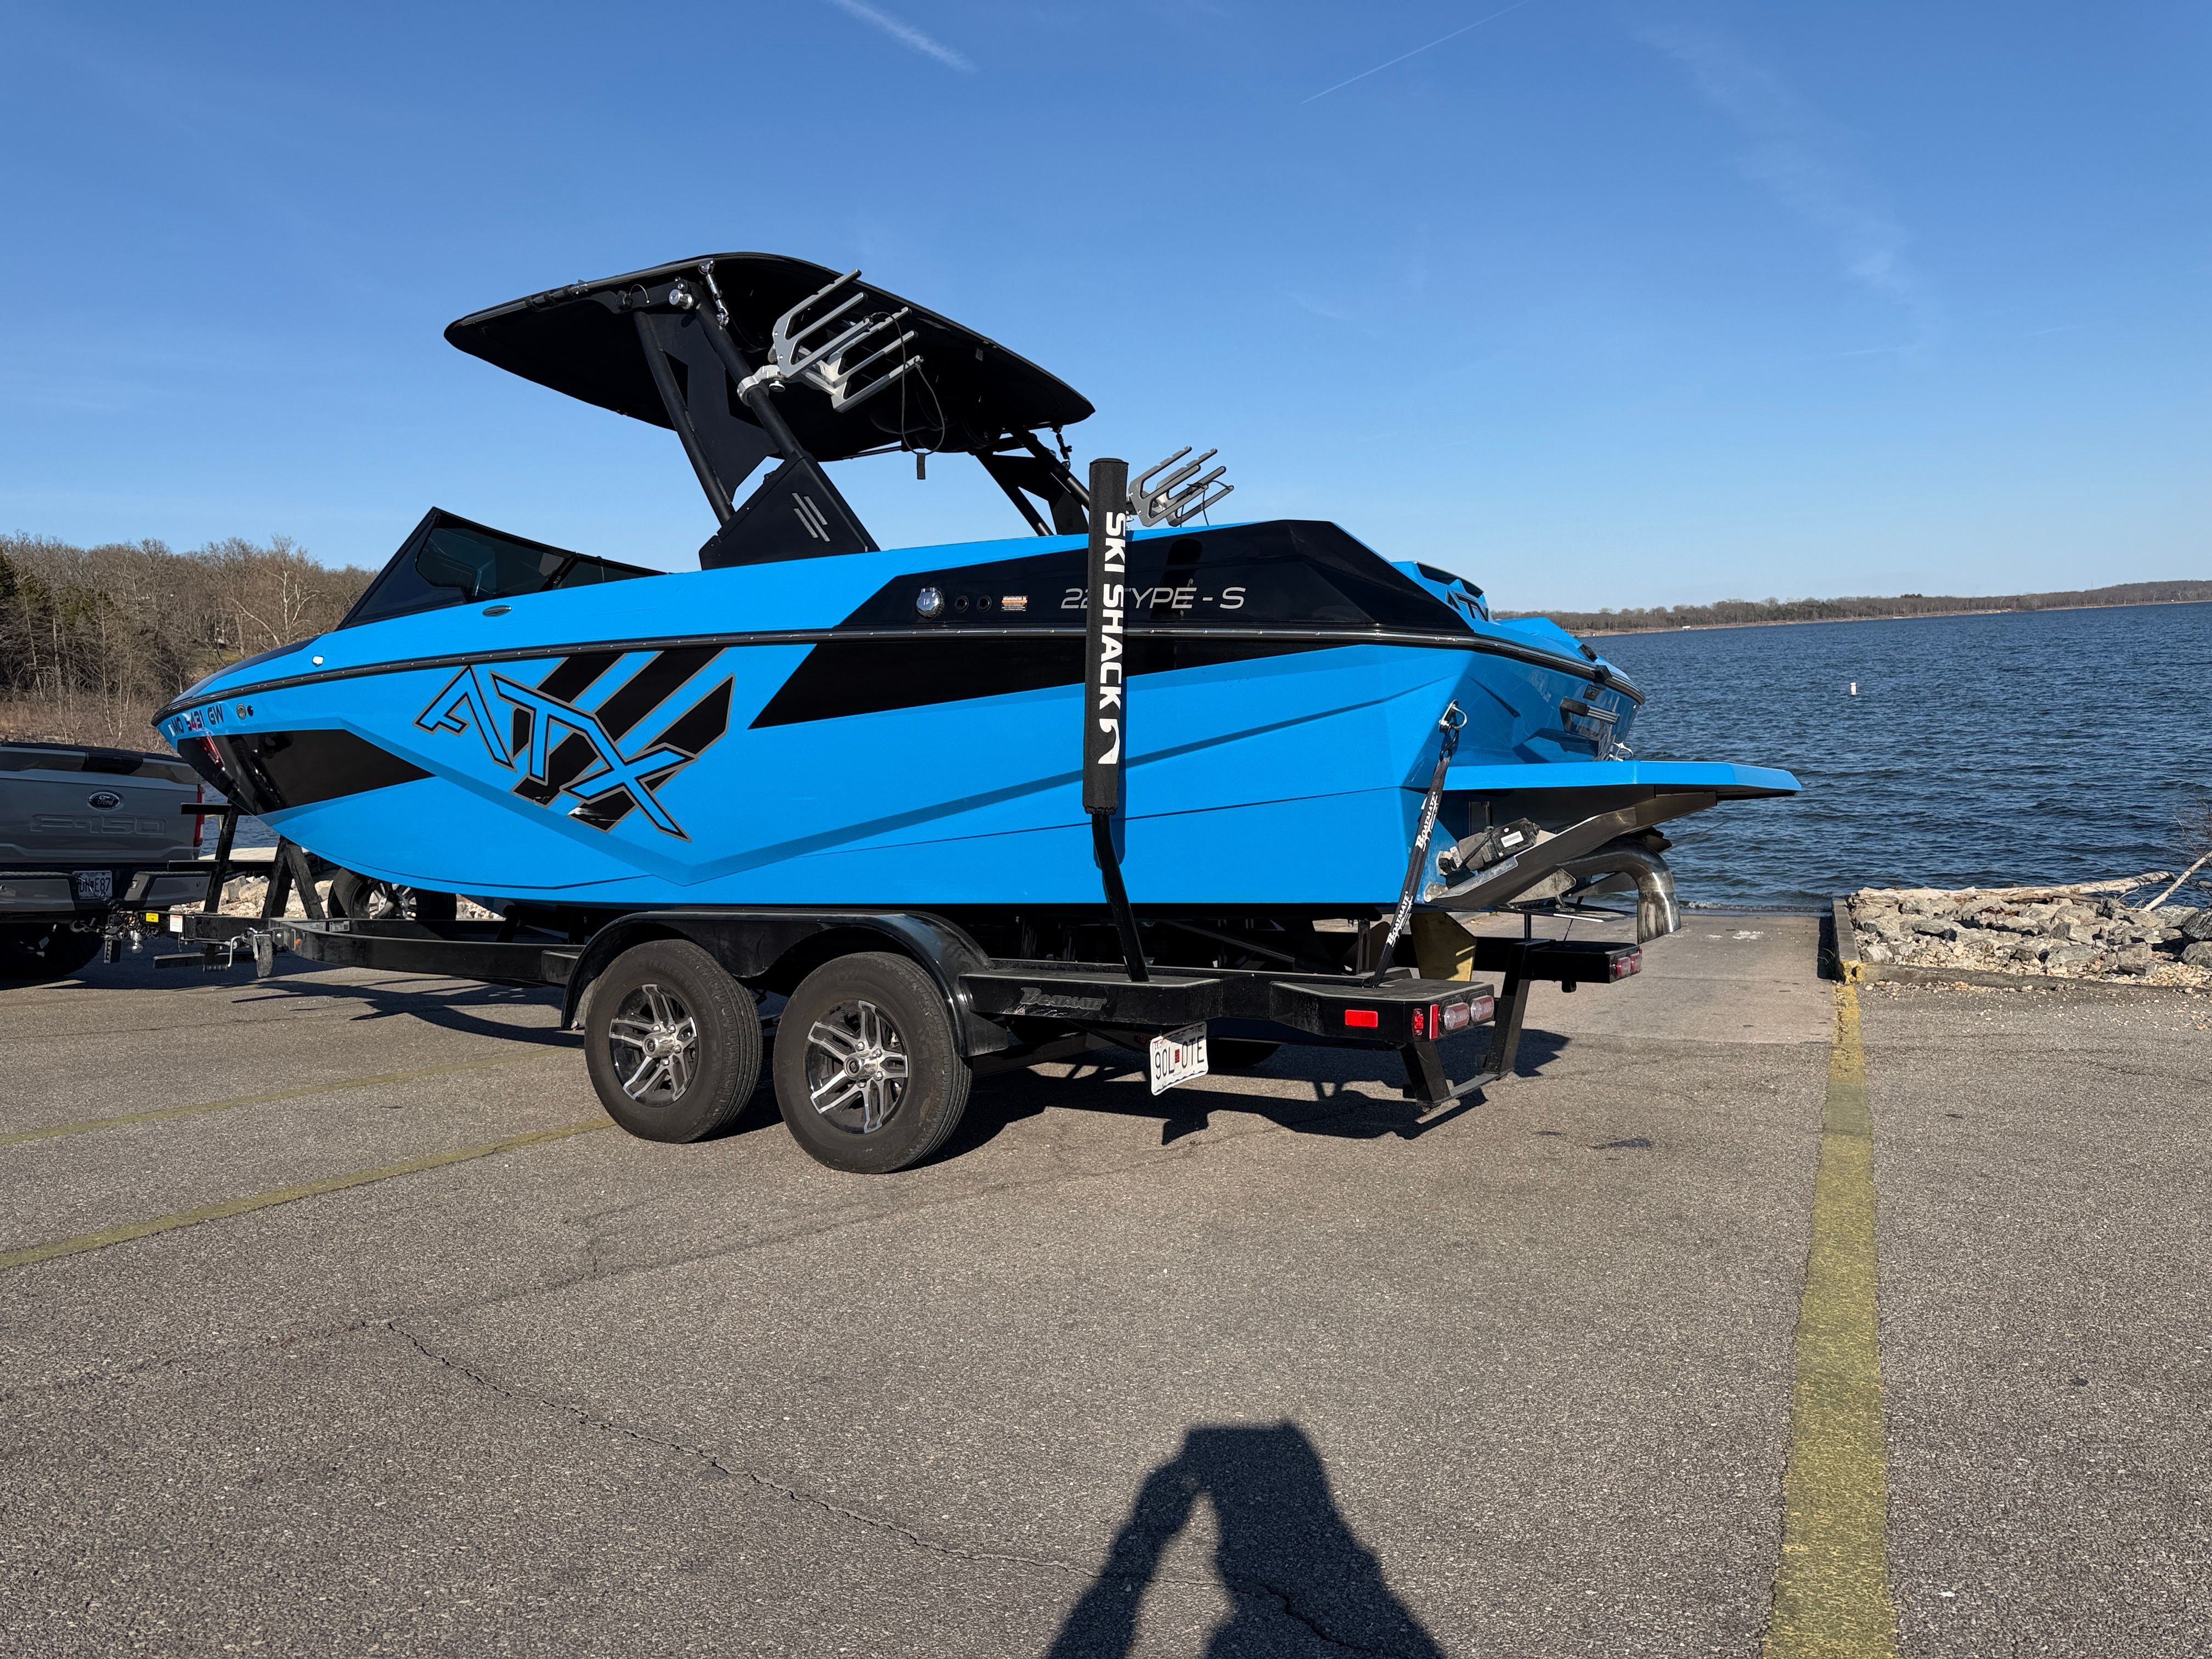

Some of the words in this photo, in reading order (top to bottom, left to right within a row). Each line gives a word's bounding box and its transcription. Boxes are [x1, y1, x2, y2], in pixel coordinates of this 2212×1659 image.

[1104, 512, 1126, 573] SKI
[1099, 584, 1124, 710] SHACK
[171, 716, 184, 736] MO
[207, 704, 224, 725] GW
[413, 664, 698, 843] ATX
[30, 814, 166, 834] F-150
[1415, 794, 1436, 849] BOATMATE
[95, 878, 111, 893] E87
[1386, 894, 1409, 946] BOATMATE
[649, 960, 685, 981] TRAILER
[1020, 987, 1104, 1011] BOATMATE
[1155, 1046, 1175, 1080] 90L
